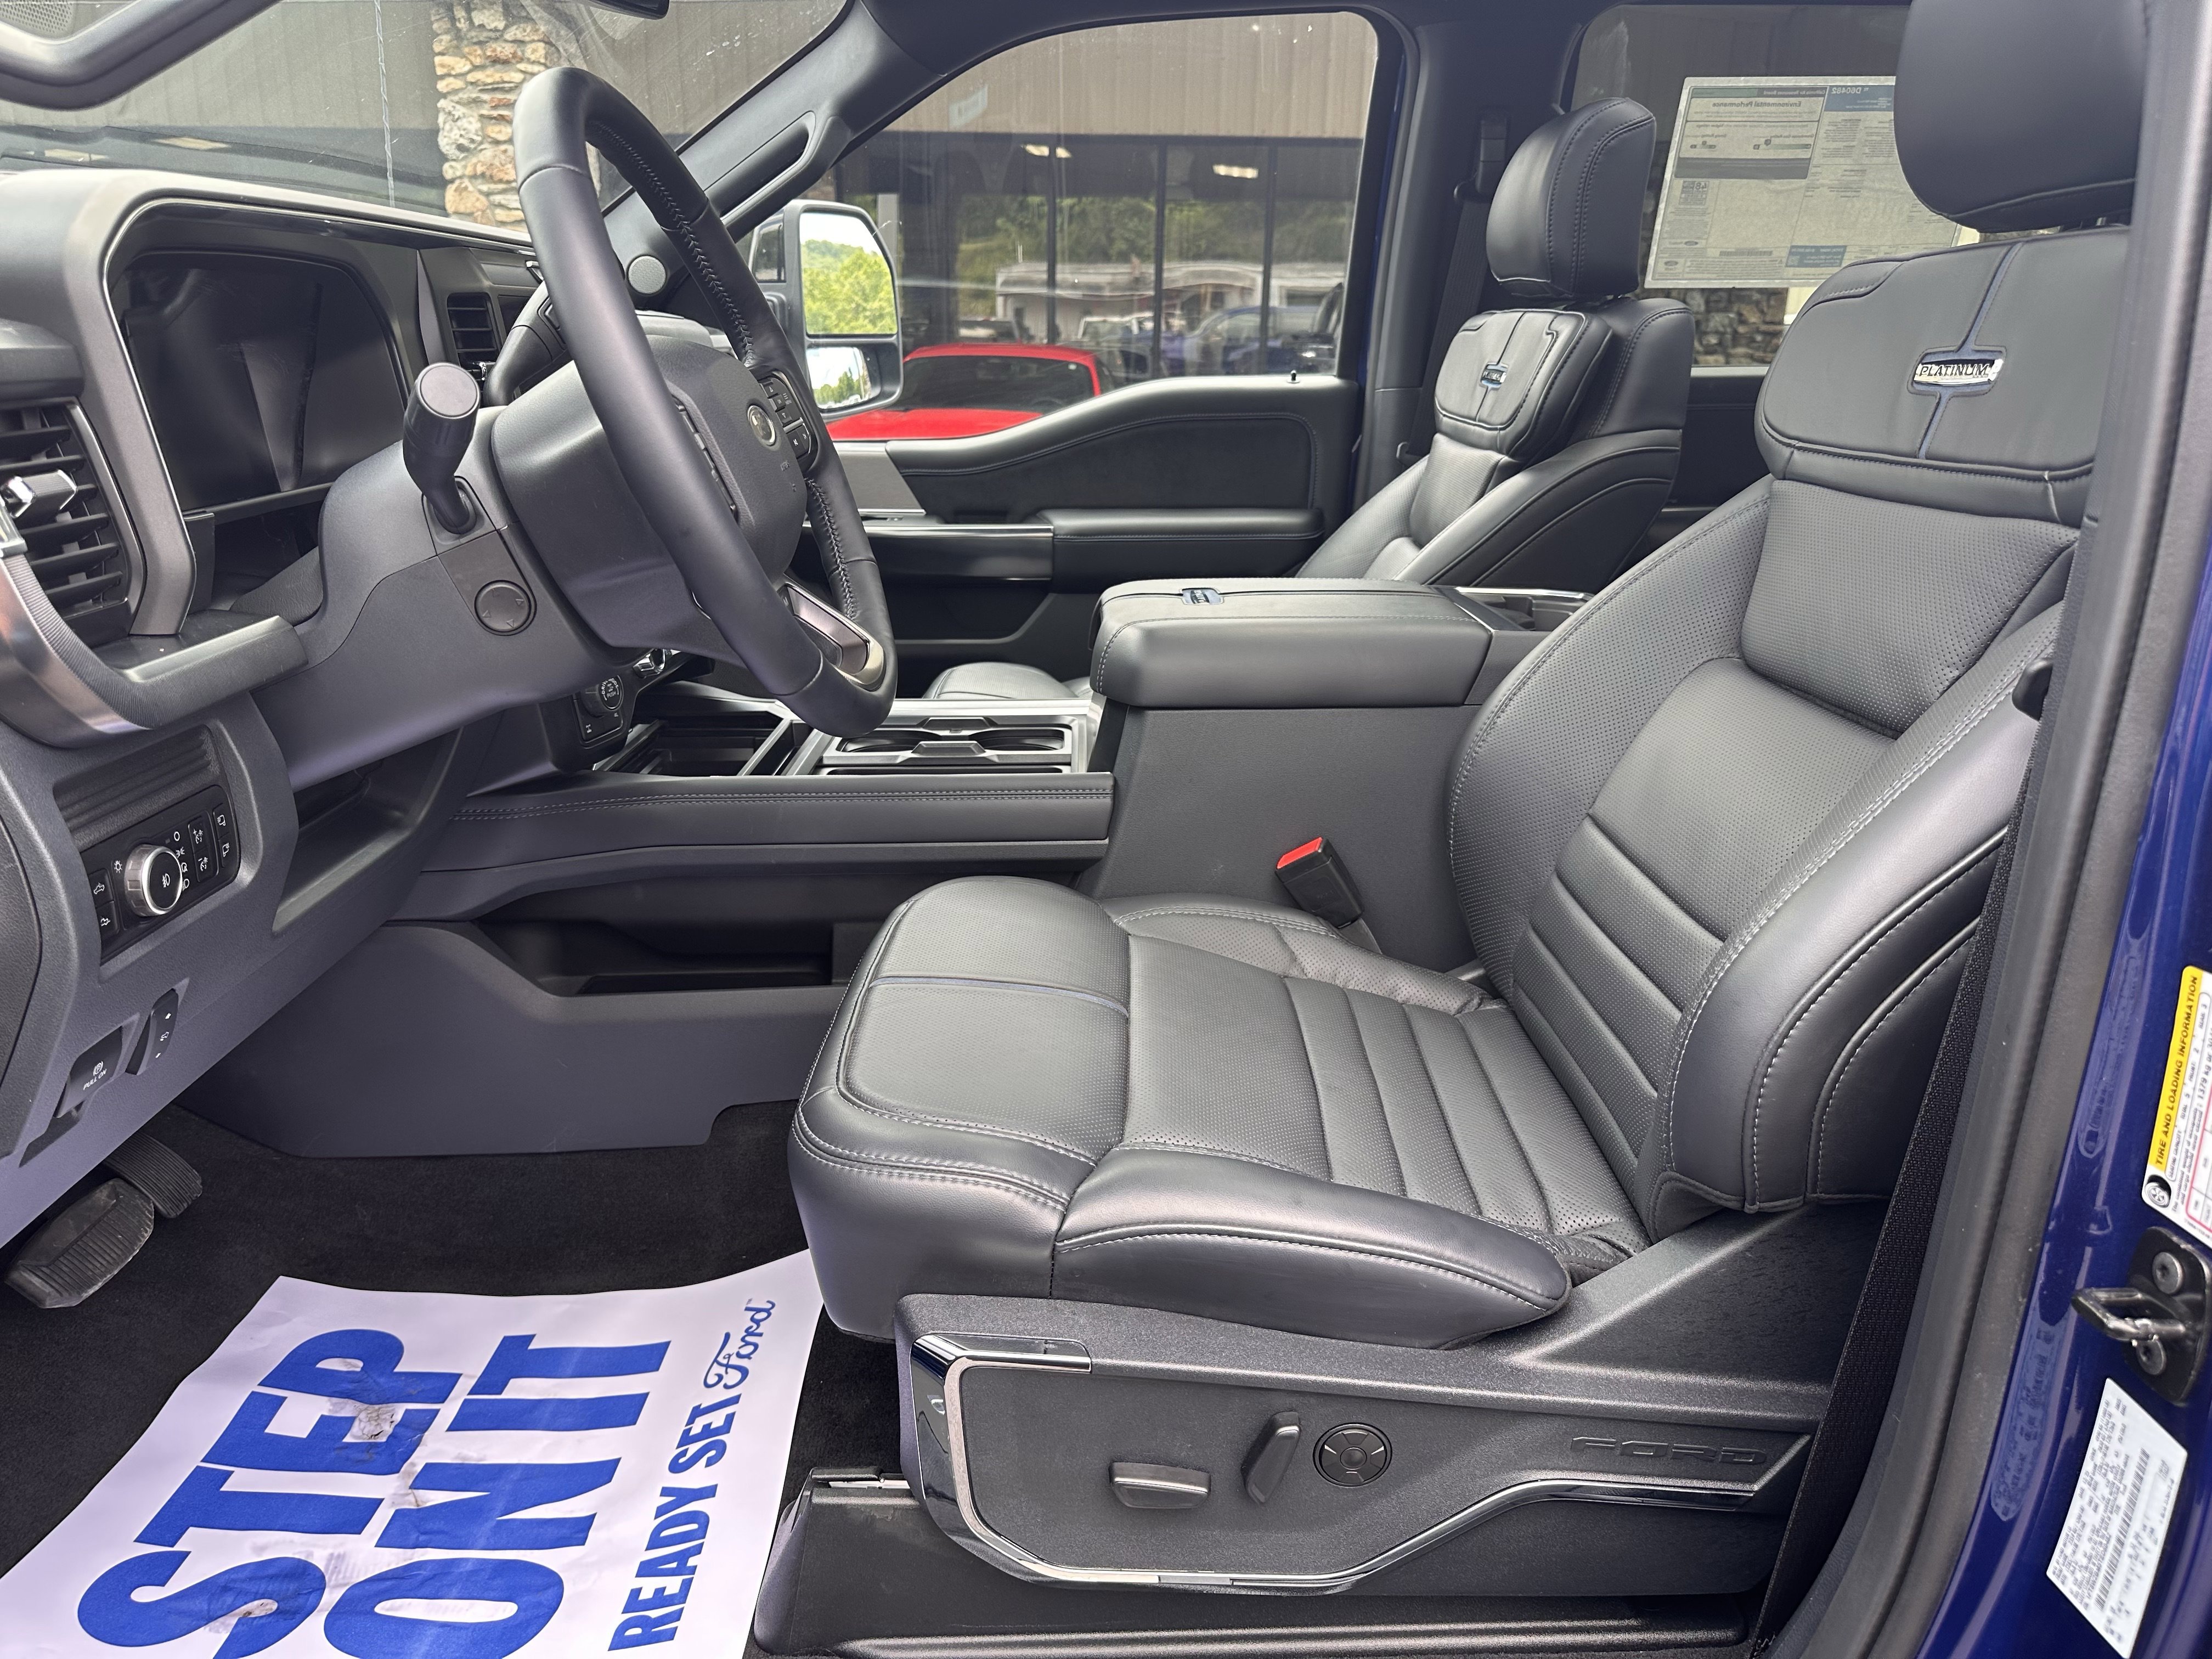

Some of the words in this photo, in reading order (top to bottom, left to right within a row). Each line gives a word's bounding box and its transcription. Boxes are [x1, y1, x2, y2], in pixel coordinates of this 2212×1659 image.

[1919, 363, 1990, 377] PLATINUM
[98, 1068, 107, 1079] ON
[2155, 1140, 2166, 1165] TIRE
[2163, 1114, 2171, 1137] AND
[2168, 1060, 2182, 1110] LOADING
[2177, 975, 2198, 1057] INFORMATION
[2198, 1077, 2207, 1099] 1379
[2204, 1065, 2211, 1076] kg
[2207, 1052, 2212, 1063] or
[445, 1334, 671, 1432] IT
[703, 1299, 775, 1390] Ford
[668, 1393, 742, 1474] SET
[1571, 1436, 1767, 1465] FORD
[78, 1329, 463, 1659] STEP
[324, 1457, 621, 1659] ON
[607, 1483, 717, 1651] READY
